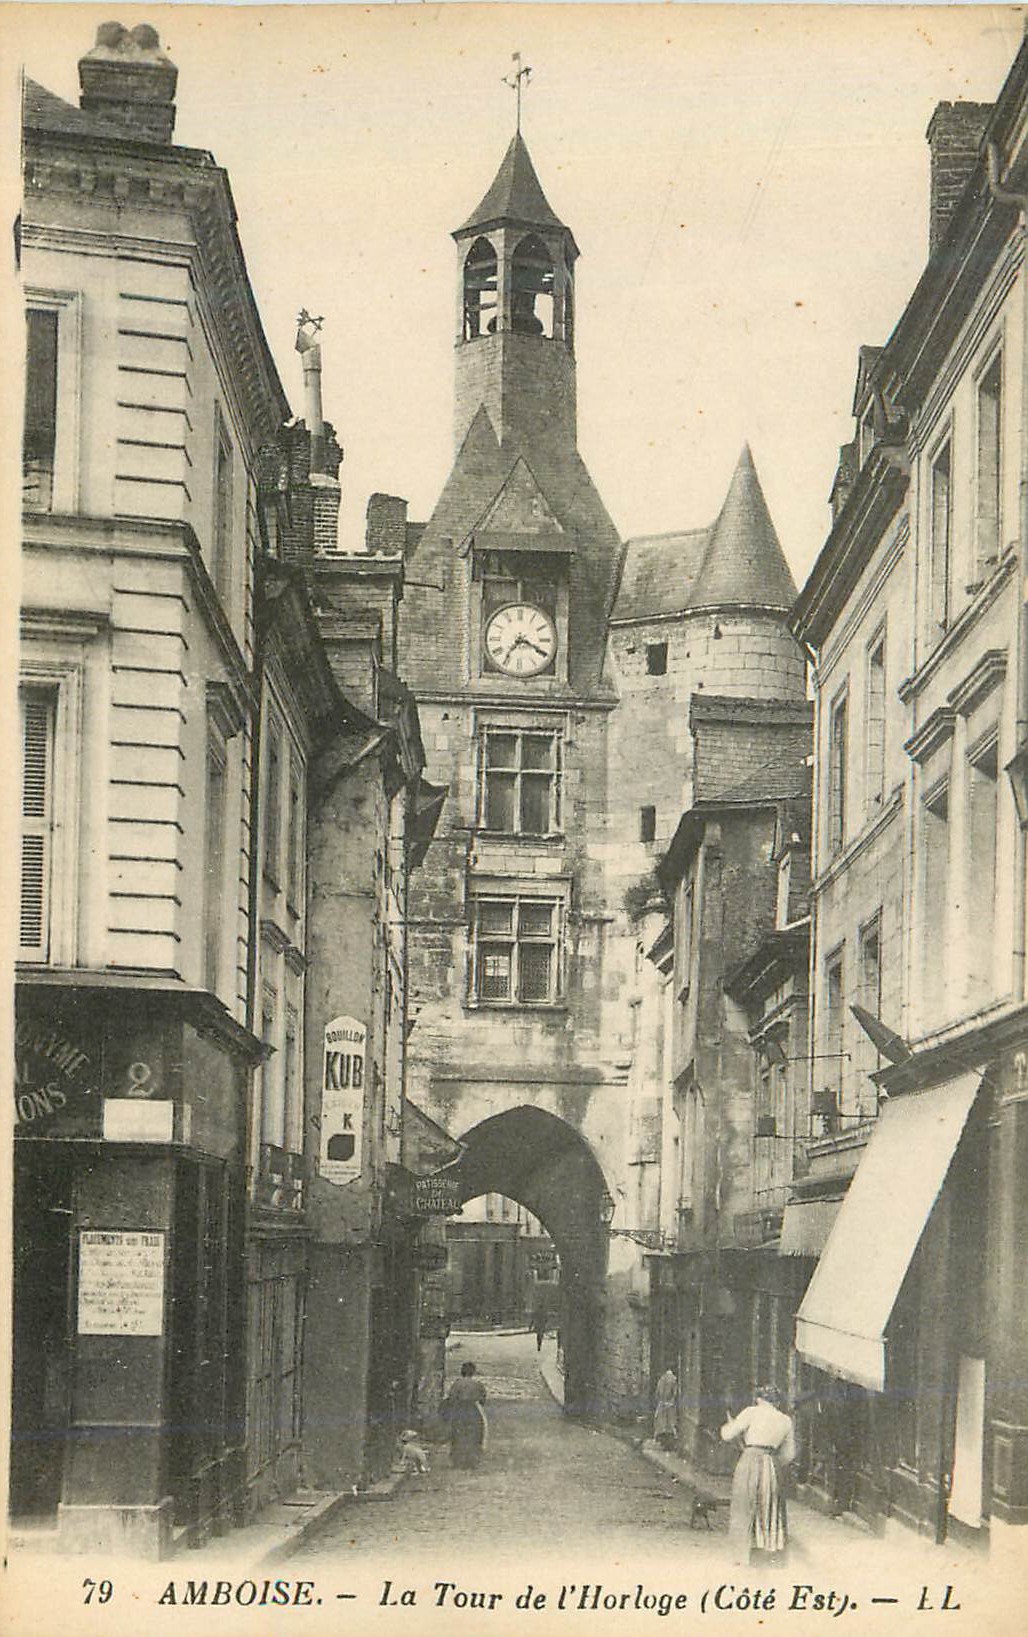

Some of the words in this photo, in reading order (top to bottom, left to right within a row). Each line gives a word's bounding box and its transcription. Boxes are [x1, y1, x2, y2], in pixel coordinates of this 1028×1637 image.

[326, 1030, 364, 1044] BOUILLON
[325, 1051, 363, 1091] KUB
[343, 1112, 354, 1130] K
